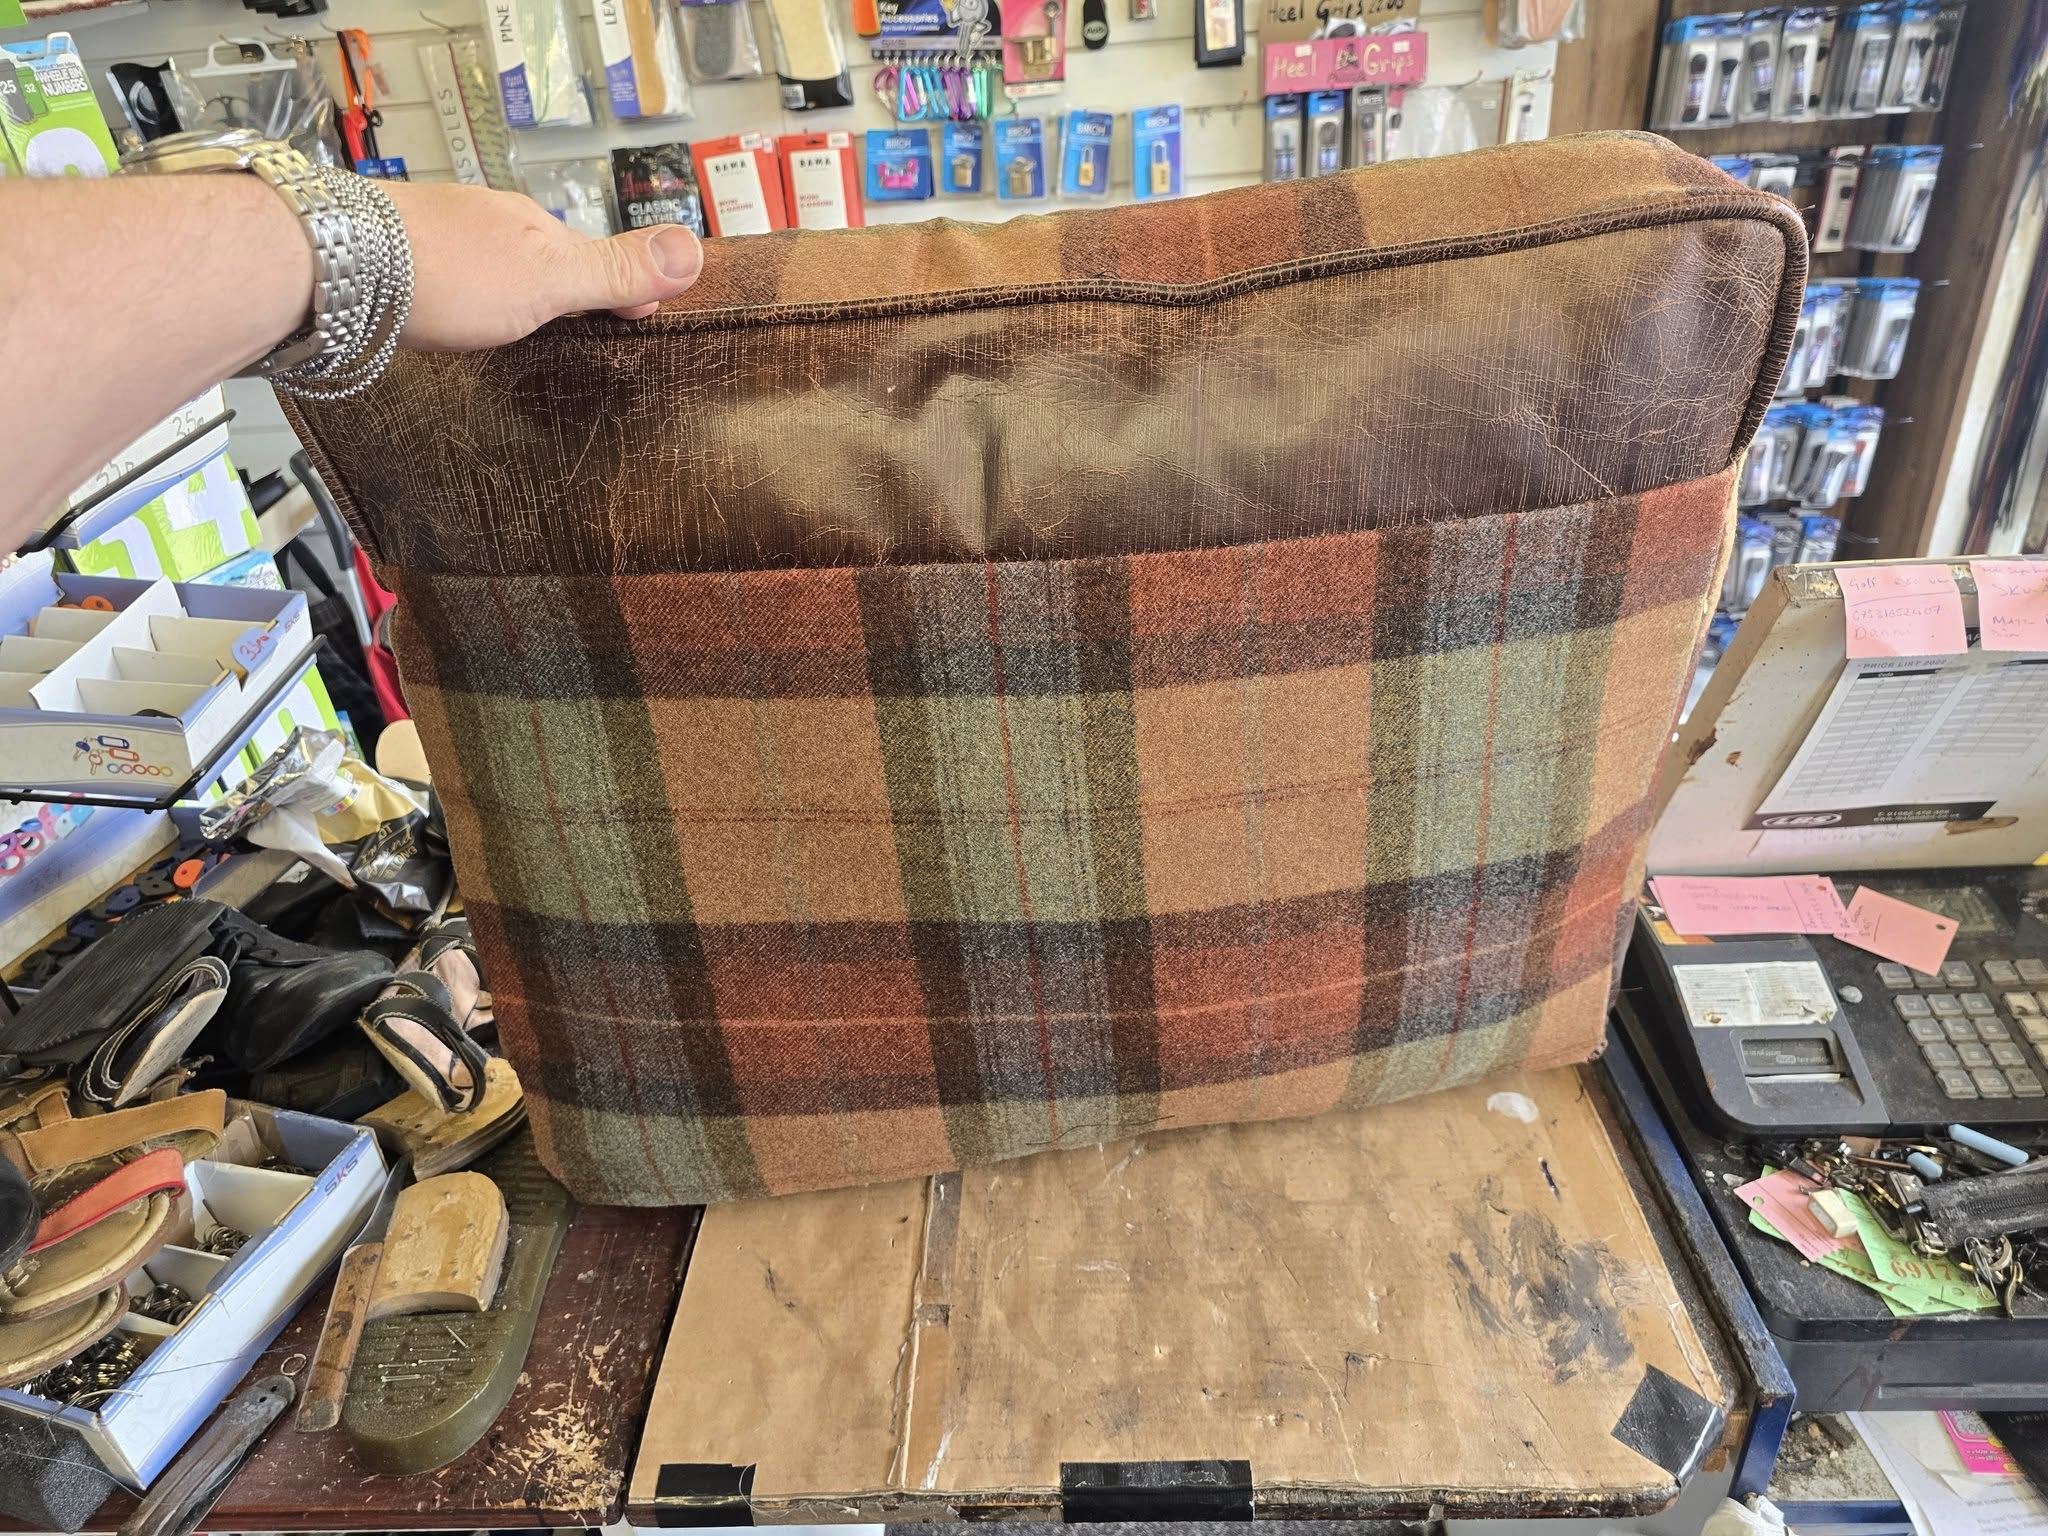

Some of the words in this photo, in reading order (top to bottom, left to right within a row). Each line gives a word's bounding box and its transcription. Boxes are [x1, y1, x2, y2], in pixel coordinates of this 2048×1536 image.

[880, 2, 898, 14] Key
[497, 4, 513, 43] PINE
[1273, 52, 1317, 79] Heel
[1363, 43, 1415, 77] Grips
[1, 80, 17, 94] 25
[24, 83, 37, 93] 32
[42, 80, 88, 96] NUMBERS
[628, 199, 681, 215] CLASSIC
[324, 1154, 358, 1196] SKS
[1890, 1260, 1952, 1281] 6917
